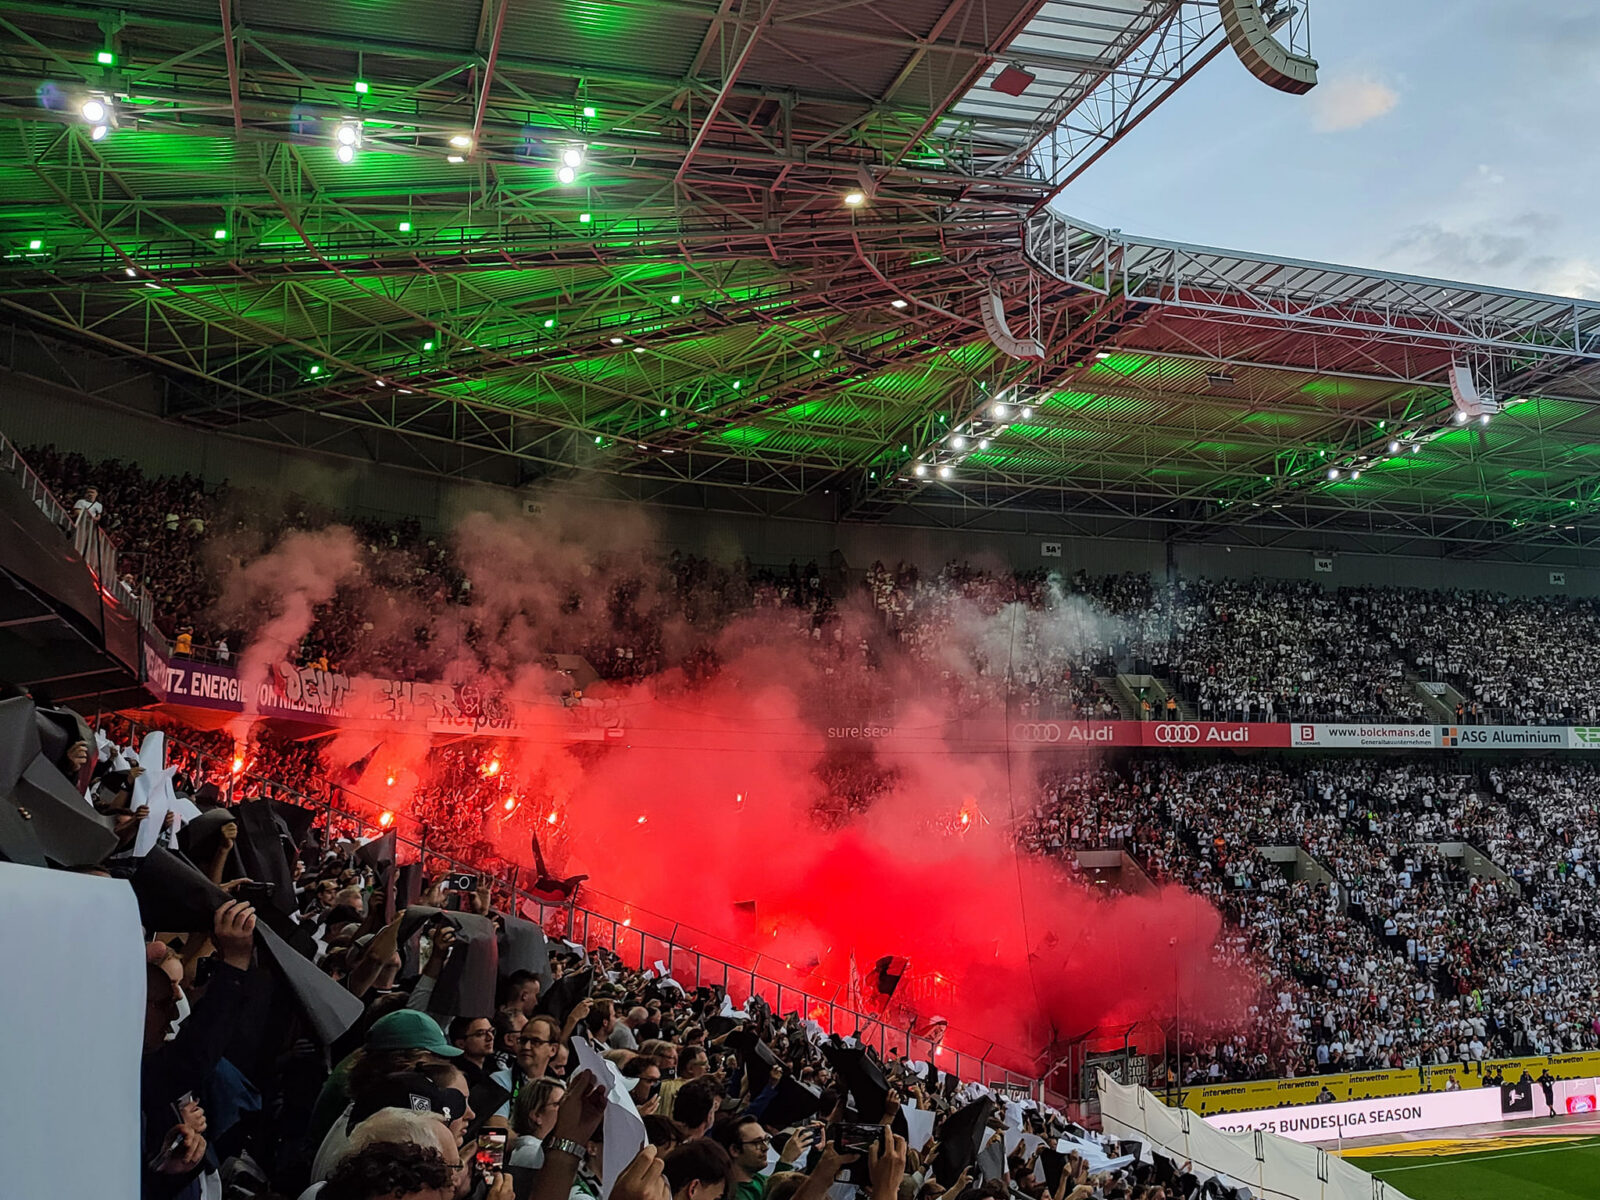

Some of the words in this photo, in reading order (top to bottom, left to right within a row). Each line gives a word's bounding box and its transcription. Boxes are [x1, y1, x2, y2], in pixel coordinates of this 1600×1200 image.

[1067, 725, 1113, 741] Audi
[1205, 726, 1249, 741] Audi
[1329, 727, 1432, 738] www.bolckmans.de
[1461, 730, 1488, 743] ASG
[1492, 730, 1561, 743] Aluminium
[1277, 1080, 1320, 1090] interwetten
[1348, 1074, 1390, 1084] interwetten
[1202, 1087, 1246, 1097] interwetten
[1280, 1113, 1368, 1134] BUNDESLIGA
[1369, 1106, 1422, 1124] SEASON
